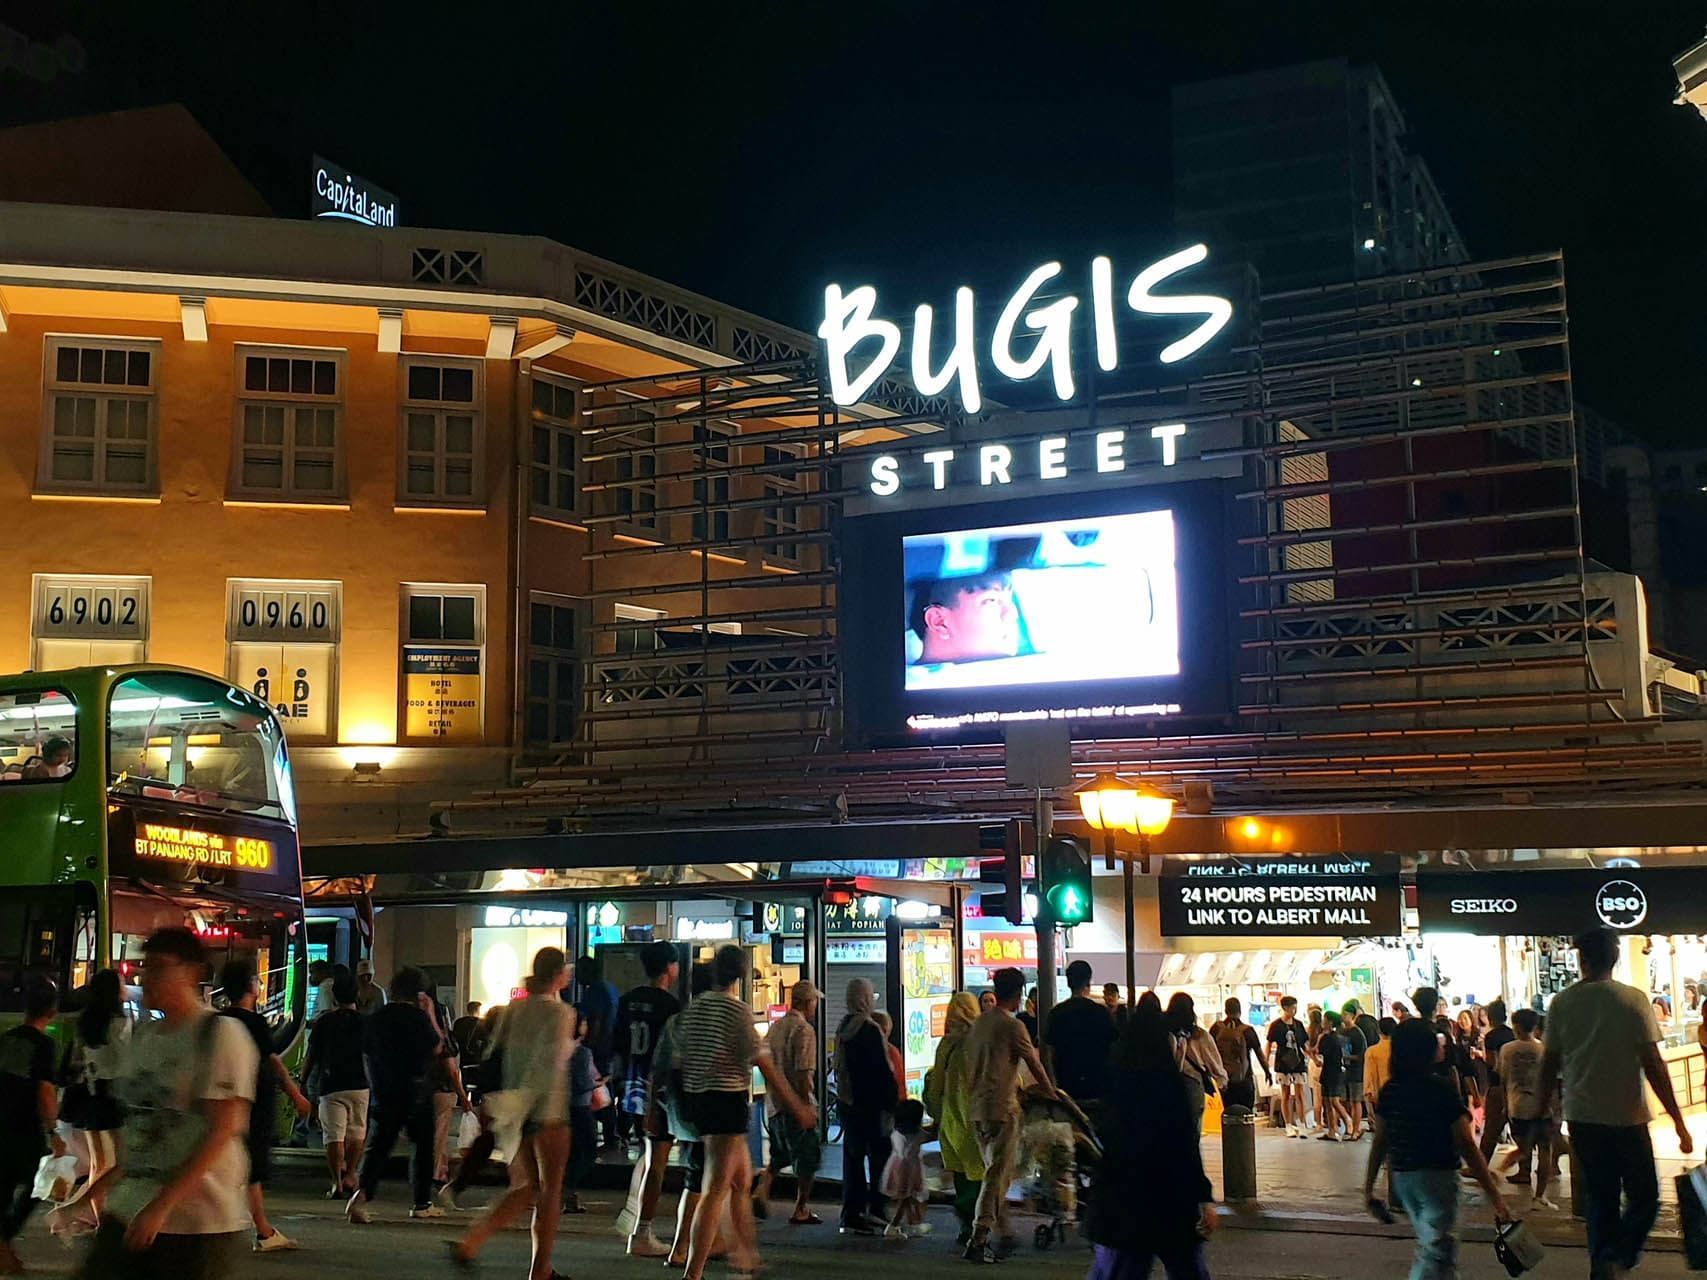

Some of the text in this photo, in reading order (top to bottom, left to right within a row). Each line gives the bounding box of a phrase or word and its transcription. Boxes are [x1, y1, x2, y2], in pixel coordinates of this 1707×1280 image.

[317, 169, 394, 227] CapitaLand
[817, 243, 1233, 415] BUGIS
[871, 424, 1187, 496] STREET
[49, 597, 137, 625] 6902
[242, 600, 327, 628] 0960
[431, 680, 452, 688] HOTEL
[145, 824, 208, 847] WOODLANDS
[135, 838, 149, 854] BT
[150, 842, 194, 860] PANJANG
[235, 837, 268, 869] 960
[1180, 886, 1377, 904] 24 HOURS PEDESTRIAN
[1450, 898, 1518, 913] SEIKO
[1602, 897, 1641, 912] BSO
[1188, 908, 1372, 925] LINK TO ALBERT MALL
